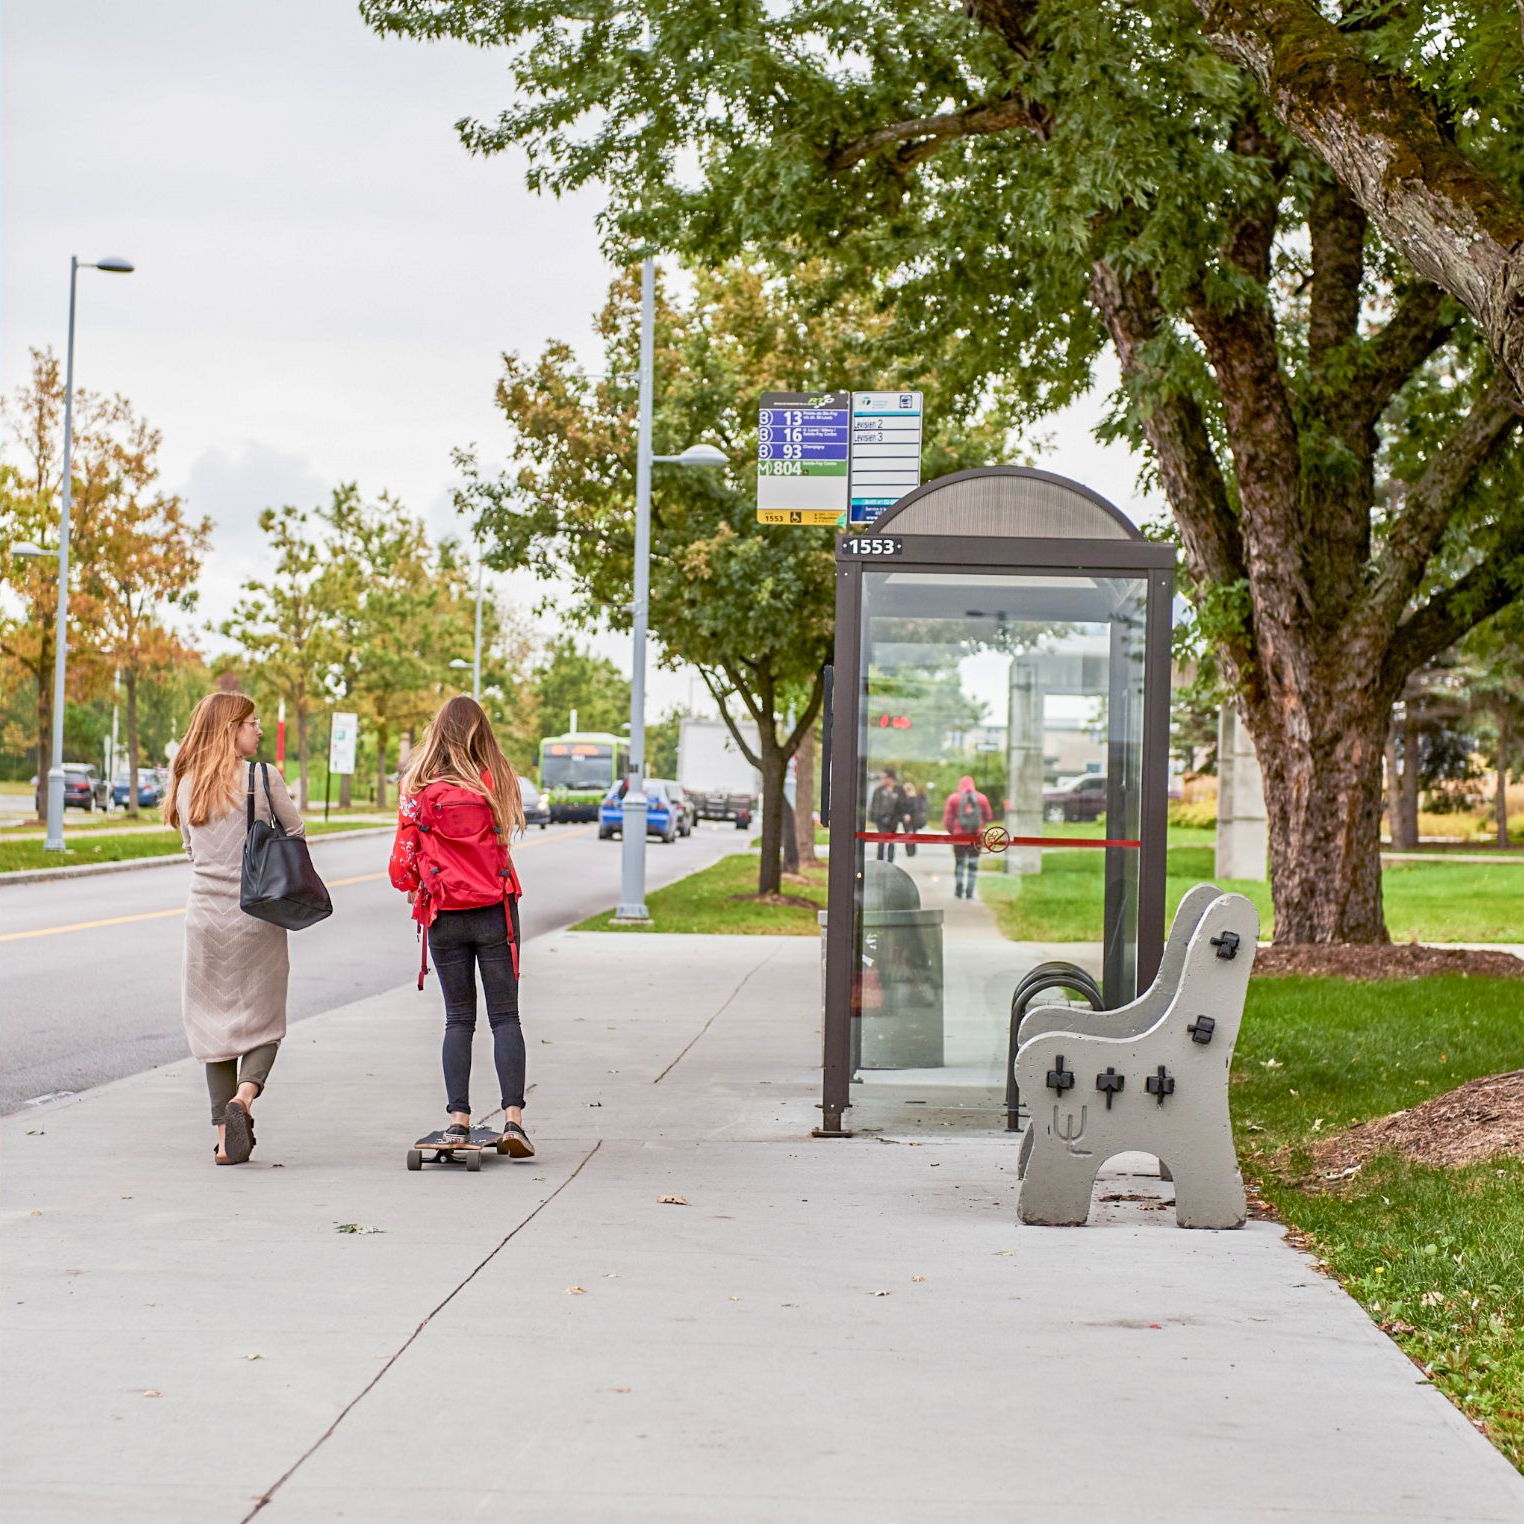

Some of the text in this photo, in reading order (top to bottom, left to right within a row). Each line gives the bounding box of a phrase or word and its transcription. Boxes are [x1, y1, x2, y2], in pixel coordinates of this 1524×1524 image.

[784, 411, 803, 426] 13
[877, 419, 883, 428] 2
[784, 428, 803, 442] 16
[877, 432, 883, 442] 3
[783, 444, 802, 459] 93
[773, 461, 802, 475] 804
[849, 539, 894, 555] 1553
